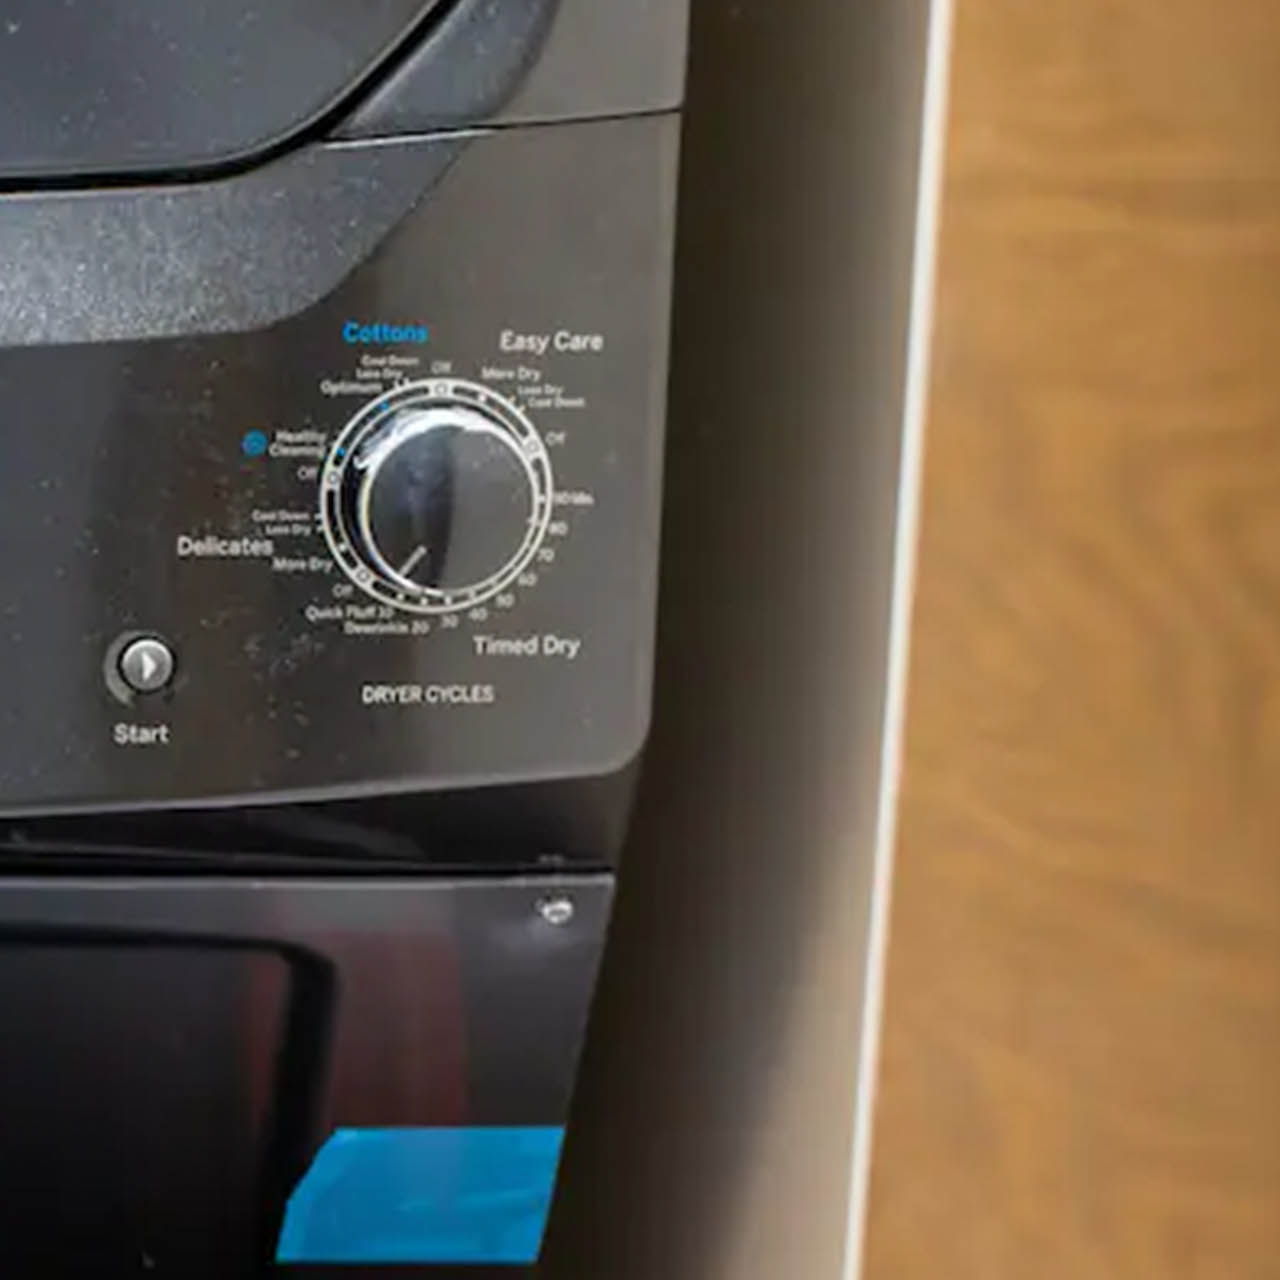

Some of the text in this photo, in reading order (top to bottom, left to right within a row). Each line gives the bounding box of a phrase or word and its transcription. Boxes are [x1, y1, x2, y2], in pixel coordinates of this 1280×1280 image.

[342, 321, 428, 343] Cottons
[499, 330, 604, 354] Easy Care
[517, 365, 541, 383] Dry
[177, 536, 274, 556] Delicates
[273, 556, 333, 573] More Dry
[305, 606, 344, 623] Quick
[473, 635, 581, 660] Timed Dry
[361, 684, 494, 704] DRYER CYCLES
[114, 723, 170, 744] Start
